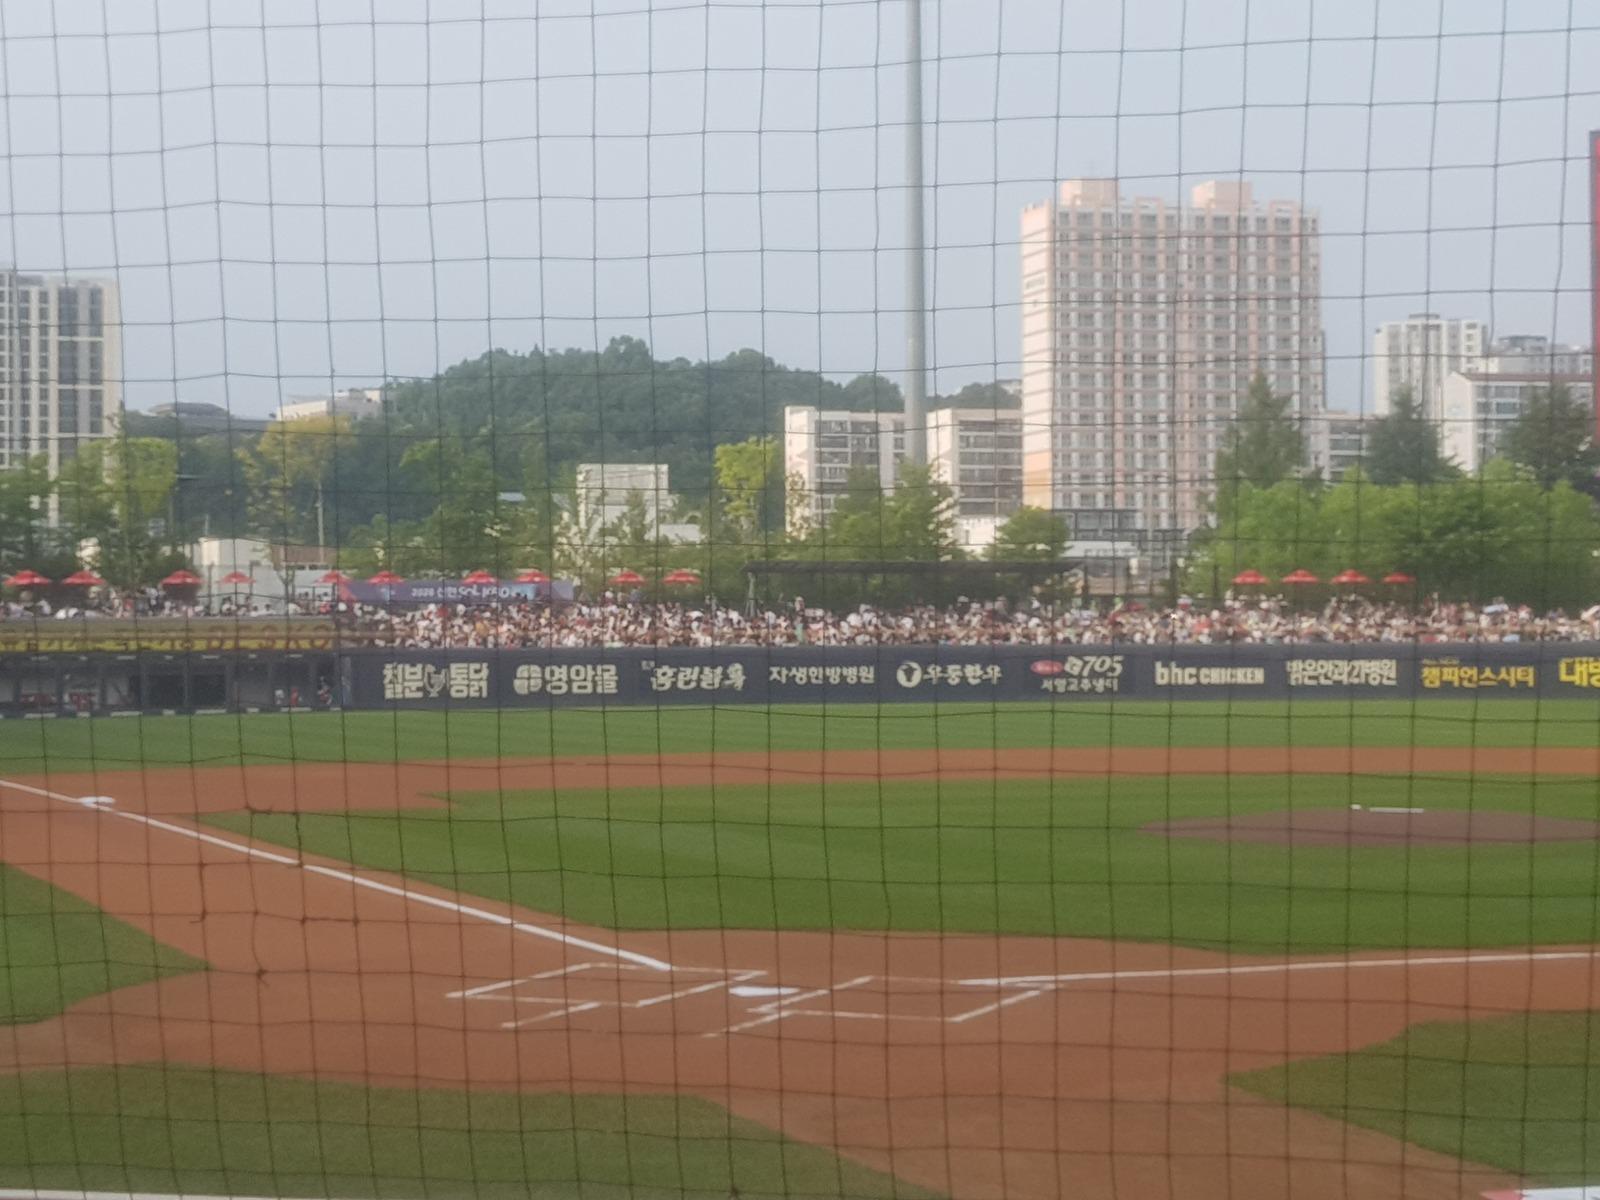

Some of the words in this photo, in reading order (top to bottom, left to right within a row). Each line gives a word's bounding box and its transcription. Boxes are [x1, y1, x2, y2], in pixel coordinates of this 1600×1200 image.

[769, 665, 875, 685] 자생한방병원
[1154, 660, 1198, 686] bhc
[1199, 666, 1265, 685] CHICKEN
[1286, 658, 1398, 687] 밝은안과21병원
[1422, 666, 1535, 688] 챔피언스시티
